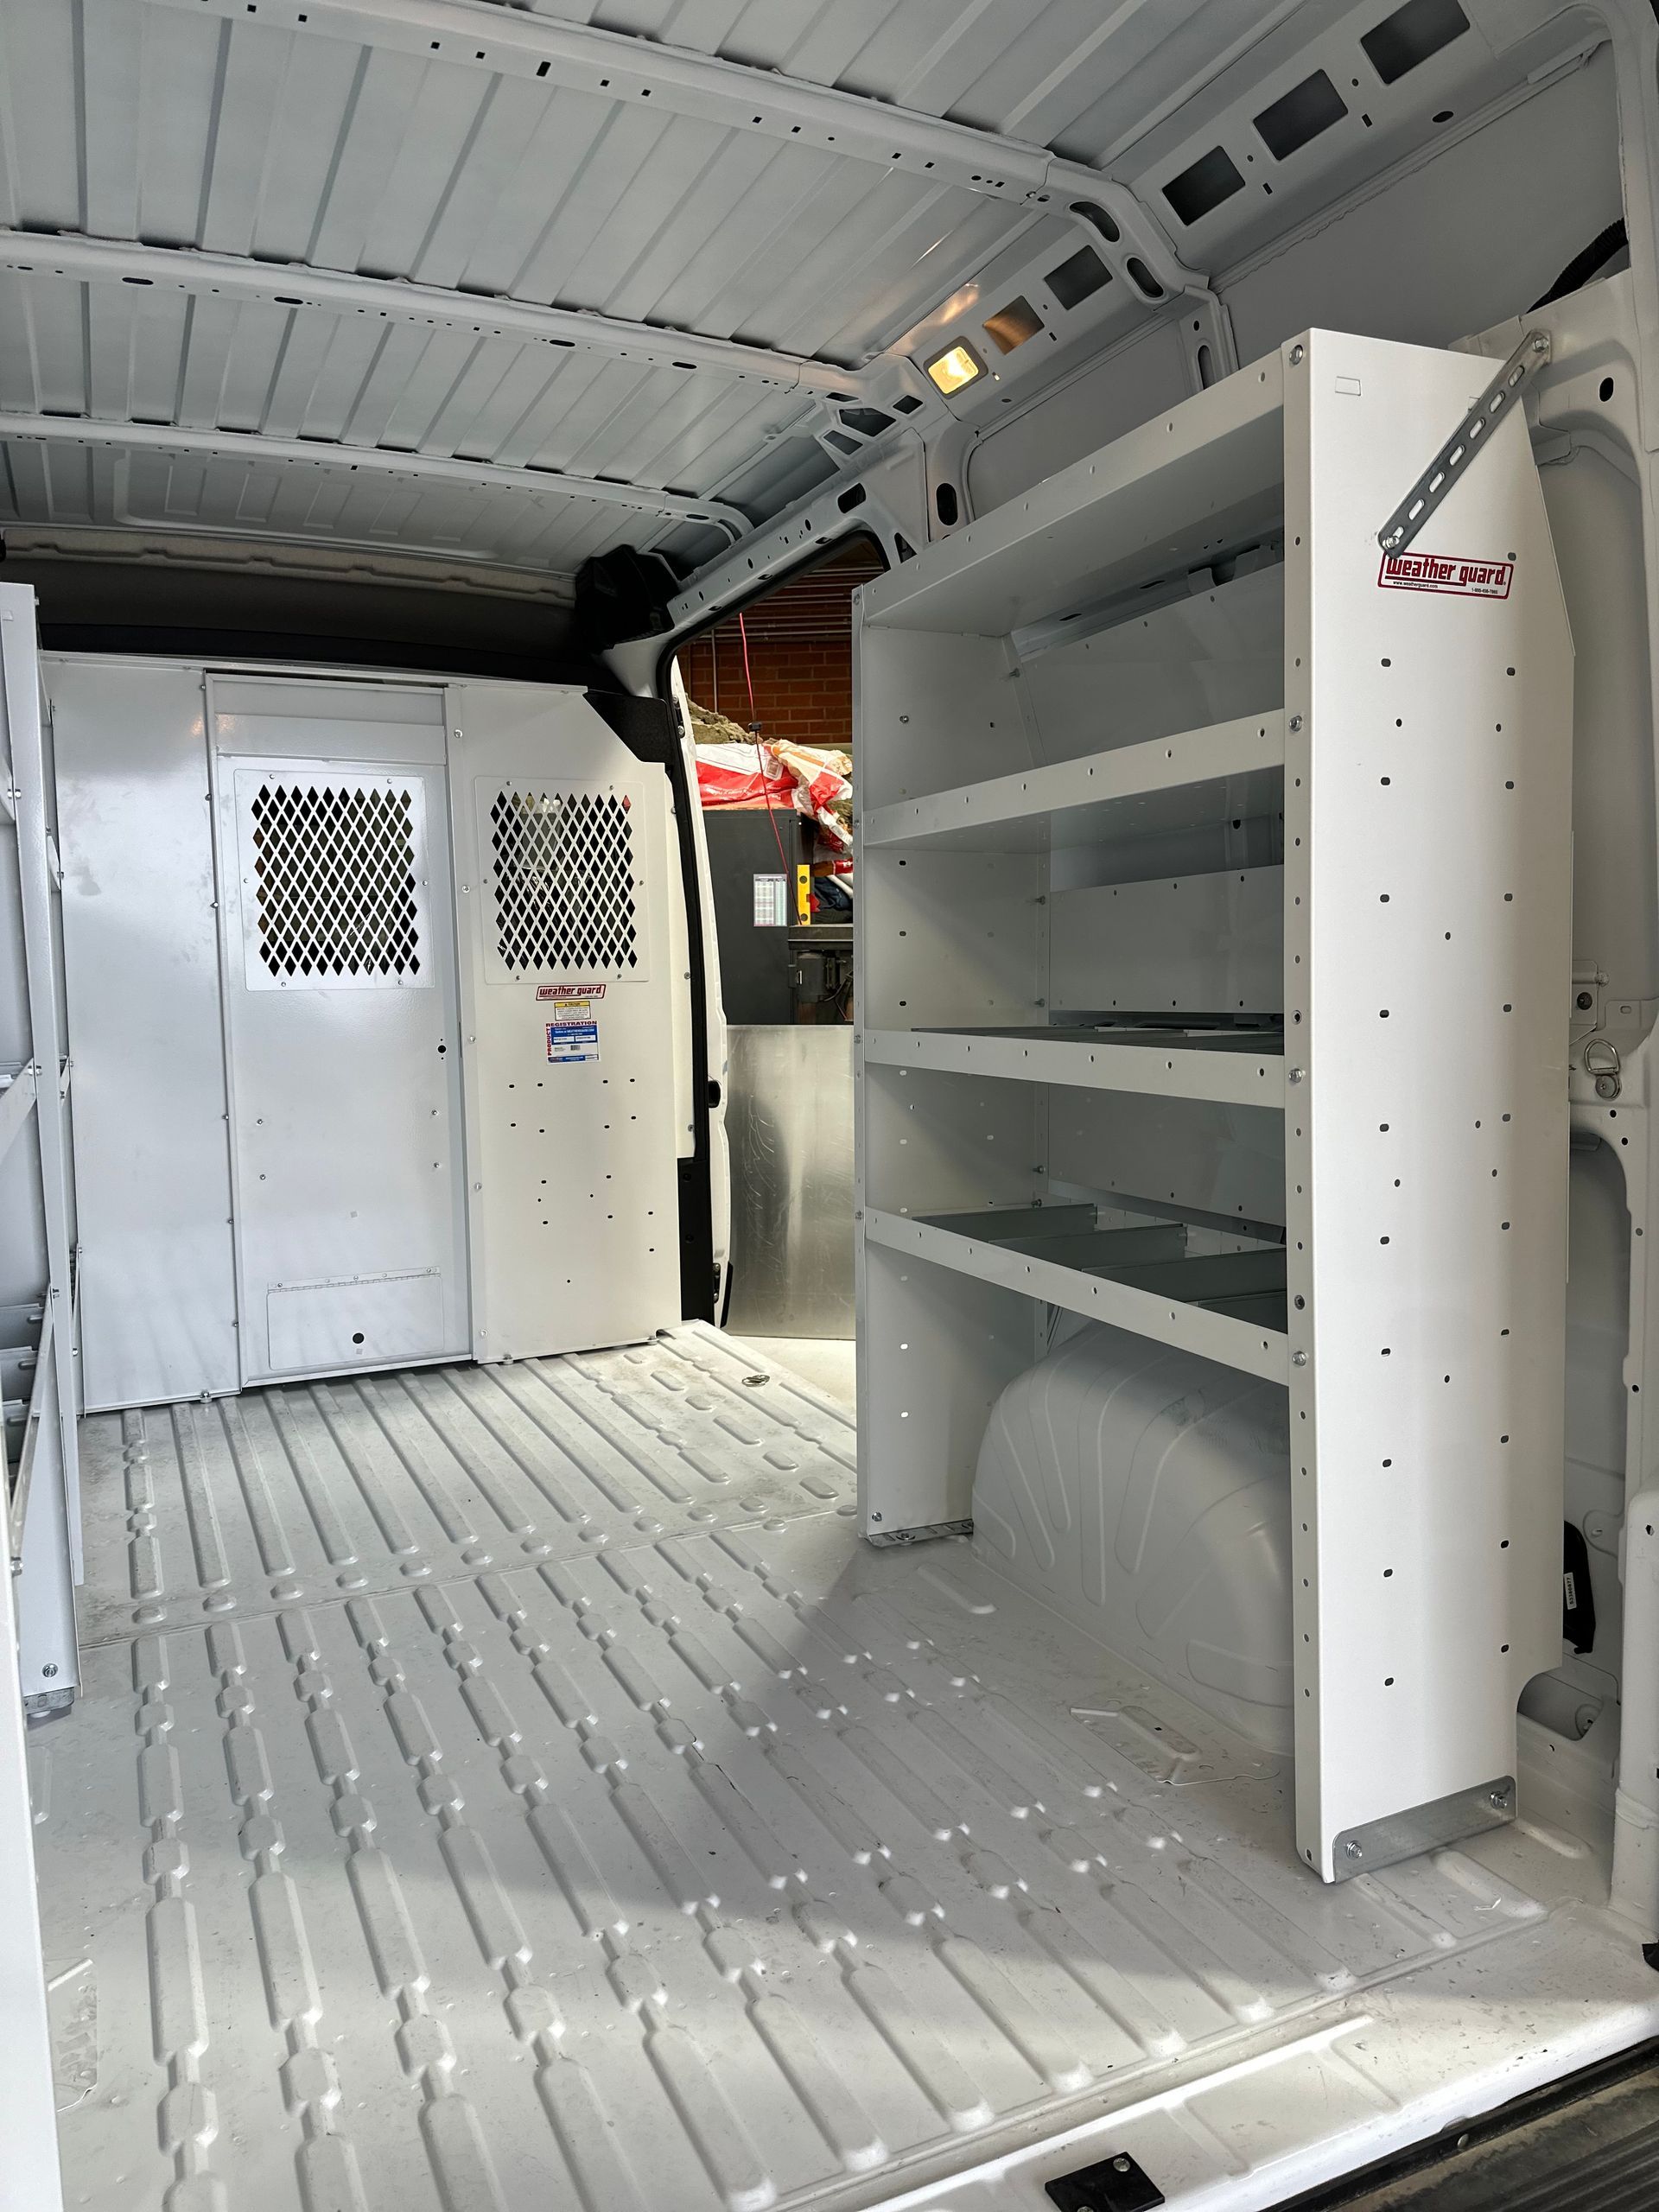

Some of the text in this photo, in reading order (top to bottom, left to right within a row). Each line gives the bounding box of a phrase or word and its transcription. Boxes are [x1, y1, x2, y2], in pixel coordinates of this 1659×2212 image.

[1386, 558, 1505, 587] weather guard
[539, 986, 601, 995] weather guard
